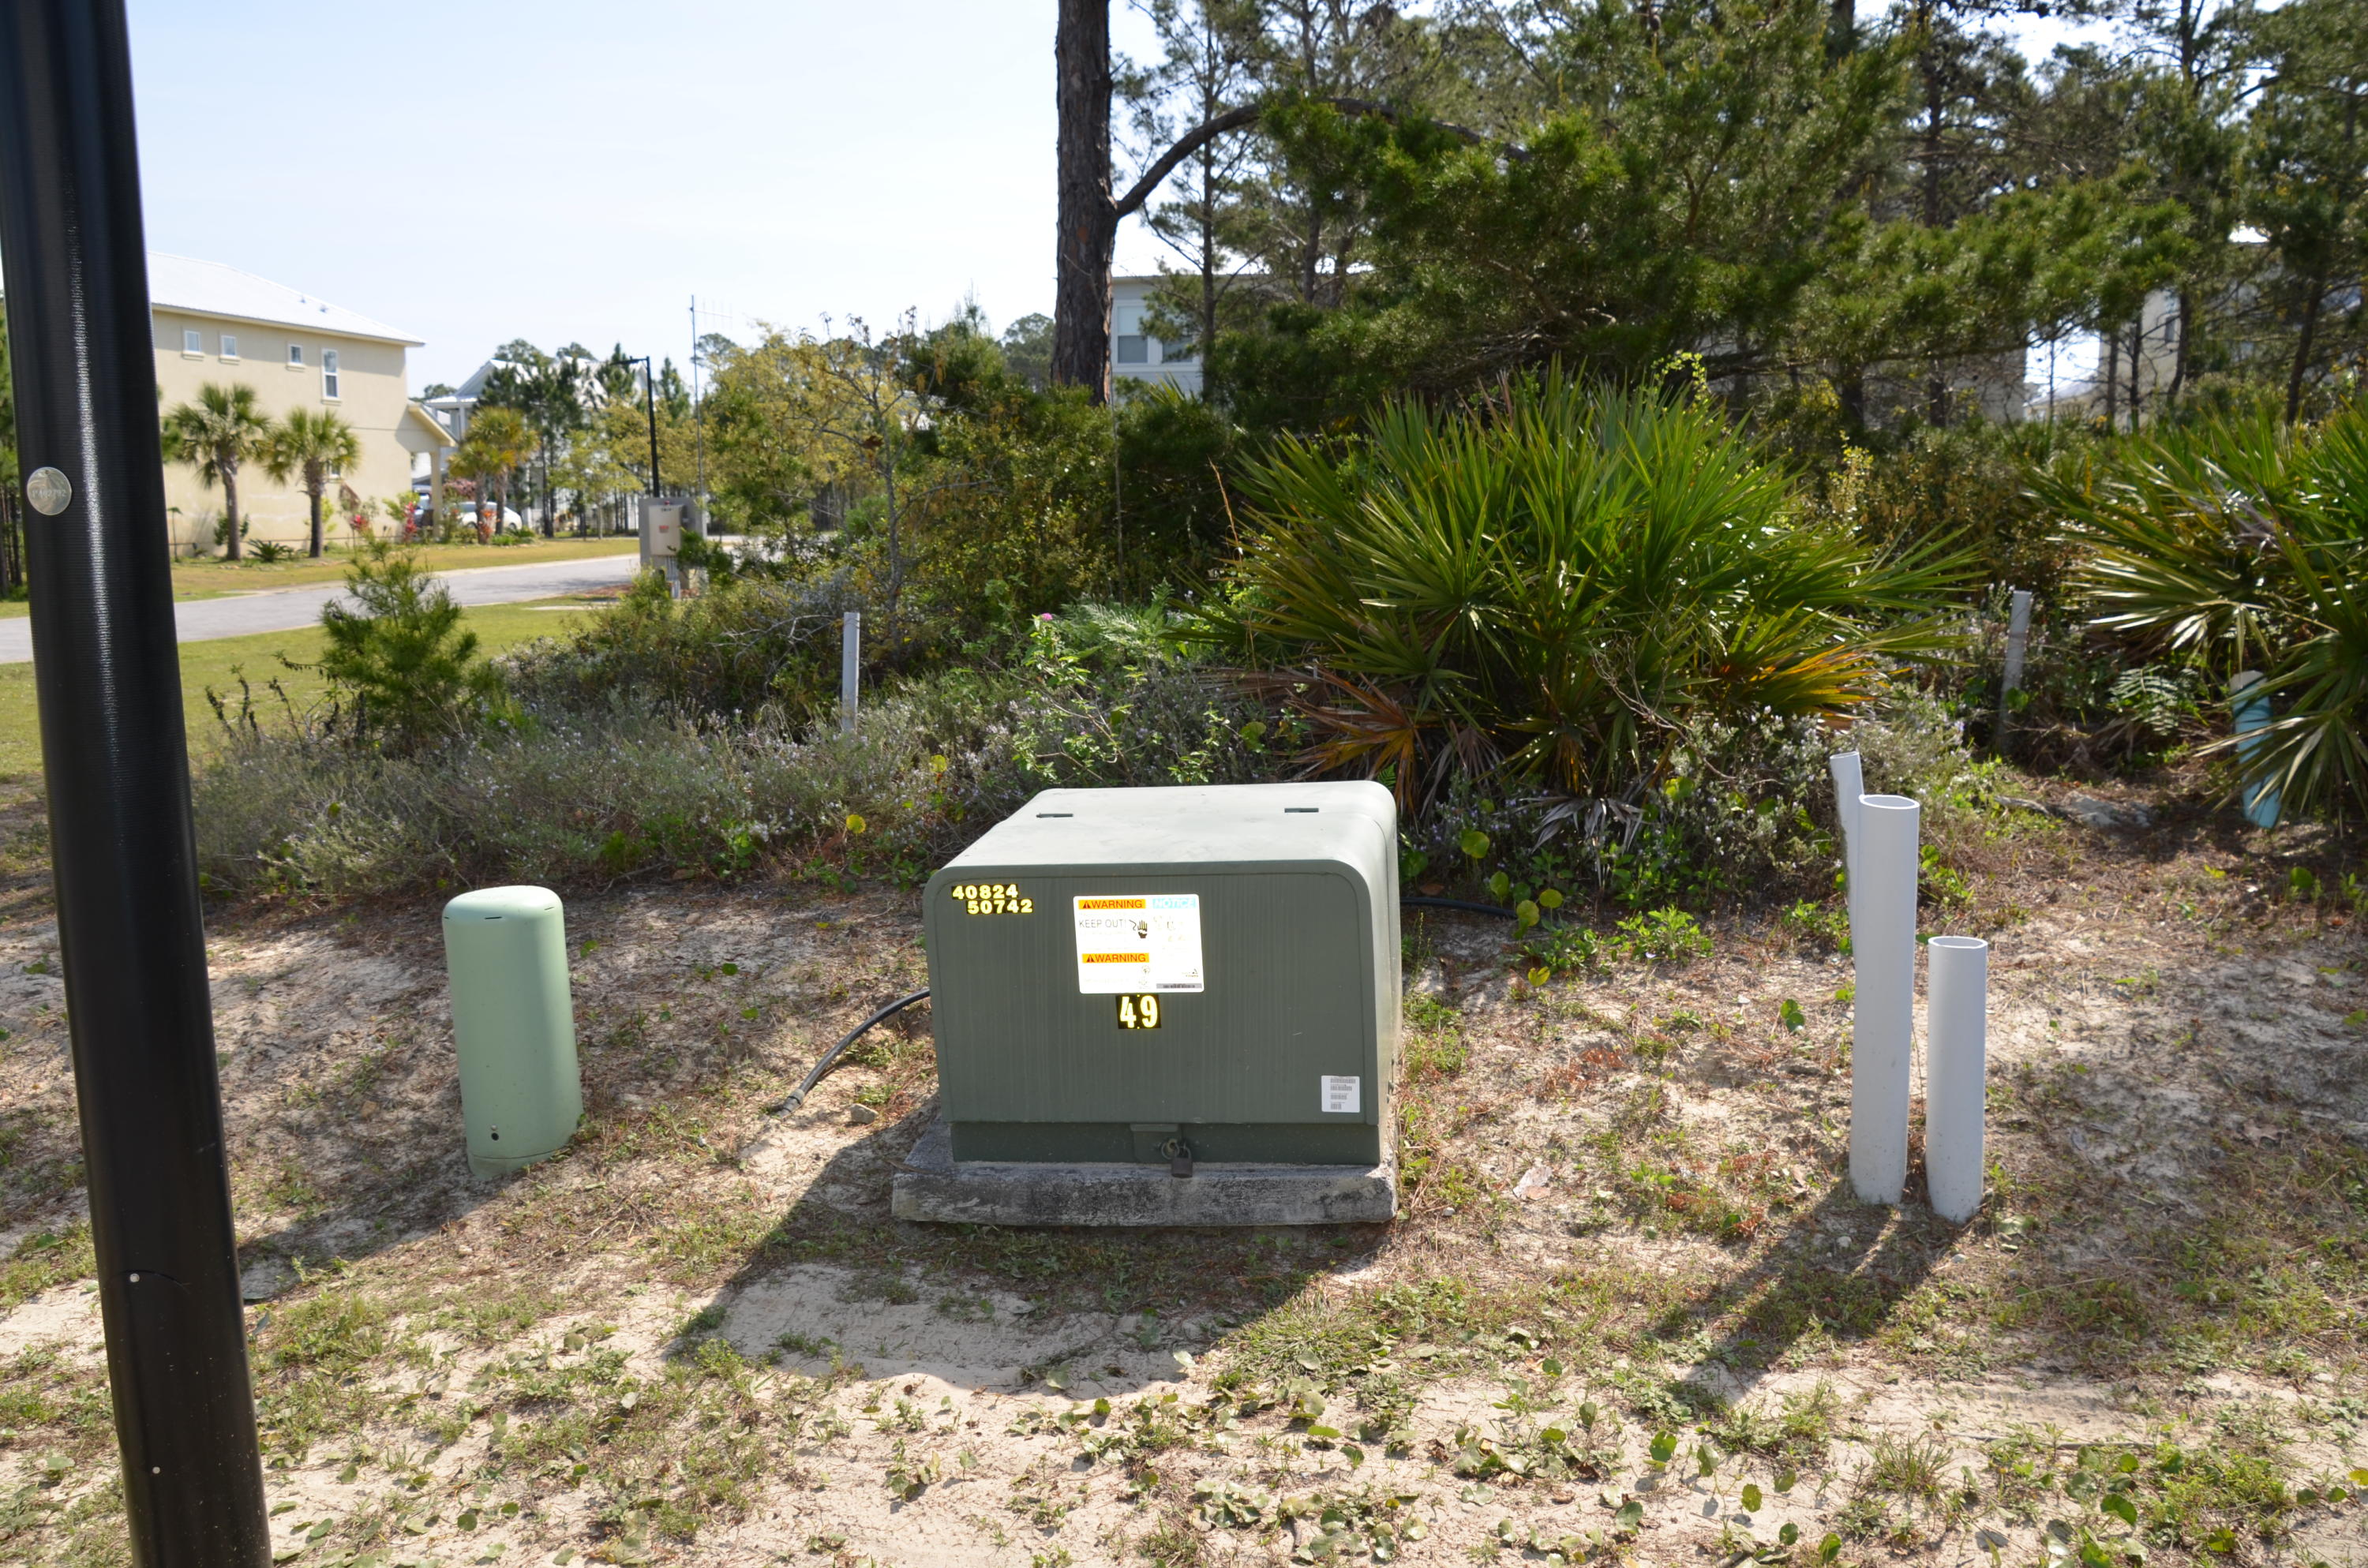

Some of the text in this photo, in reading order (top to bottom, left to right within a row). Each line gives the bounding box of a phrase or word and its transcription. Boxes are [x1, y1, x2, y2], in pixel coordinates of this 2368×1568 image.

[952, 884, 1018, 900] 40824
[967, 899, 1032, 915] 50742
[1092, 900, 1143, 909] WARNING
[1153, 898, 1195, 908] NOTICE
[1078, 919, 1103, 929] KEEP
[1095, 953, 1146, 963] WARNING
[1119, 995, 1158, 1028] 49
